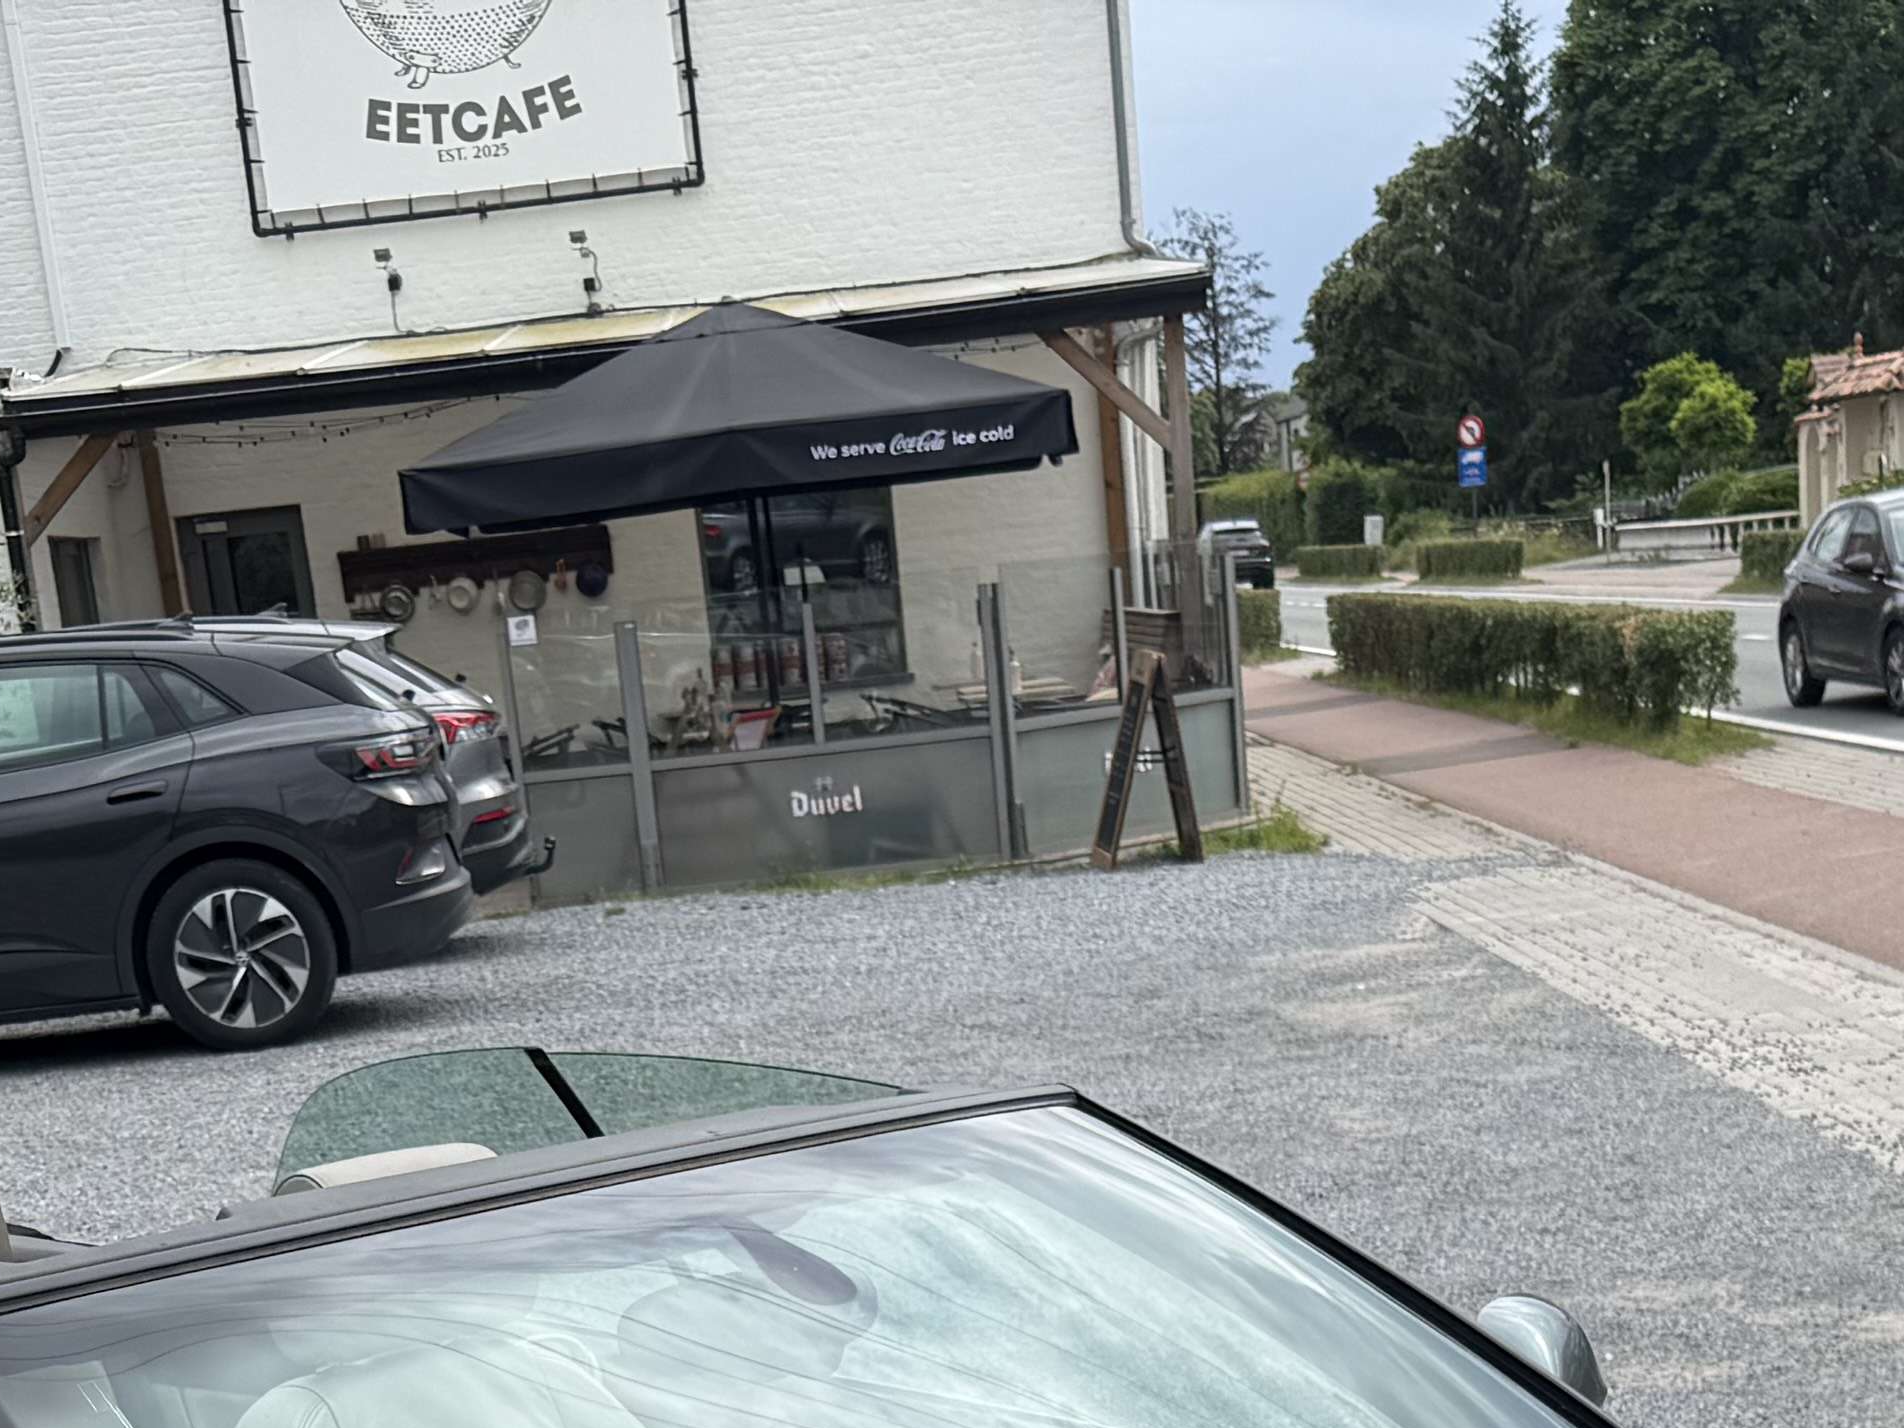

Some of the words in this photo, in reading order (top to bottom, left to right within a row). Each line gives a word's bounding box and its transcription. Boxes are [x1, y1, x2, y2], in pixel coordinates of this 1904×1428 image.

[365, 75, 583, 145] EETCAFE
[437, 147, 468, 164] EST.
[471, 142, 510, 160] 2025
[810, 445, 838, 461] We
[841, 441, 886, 458] serve
[979, 424, 1015, 443] cold
[790, 784, 864, 818] Duvel
